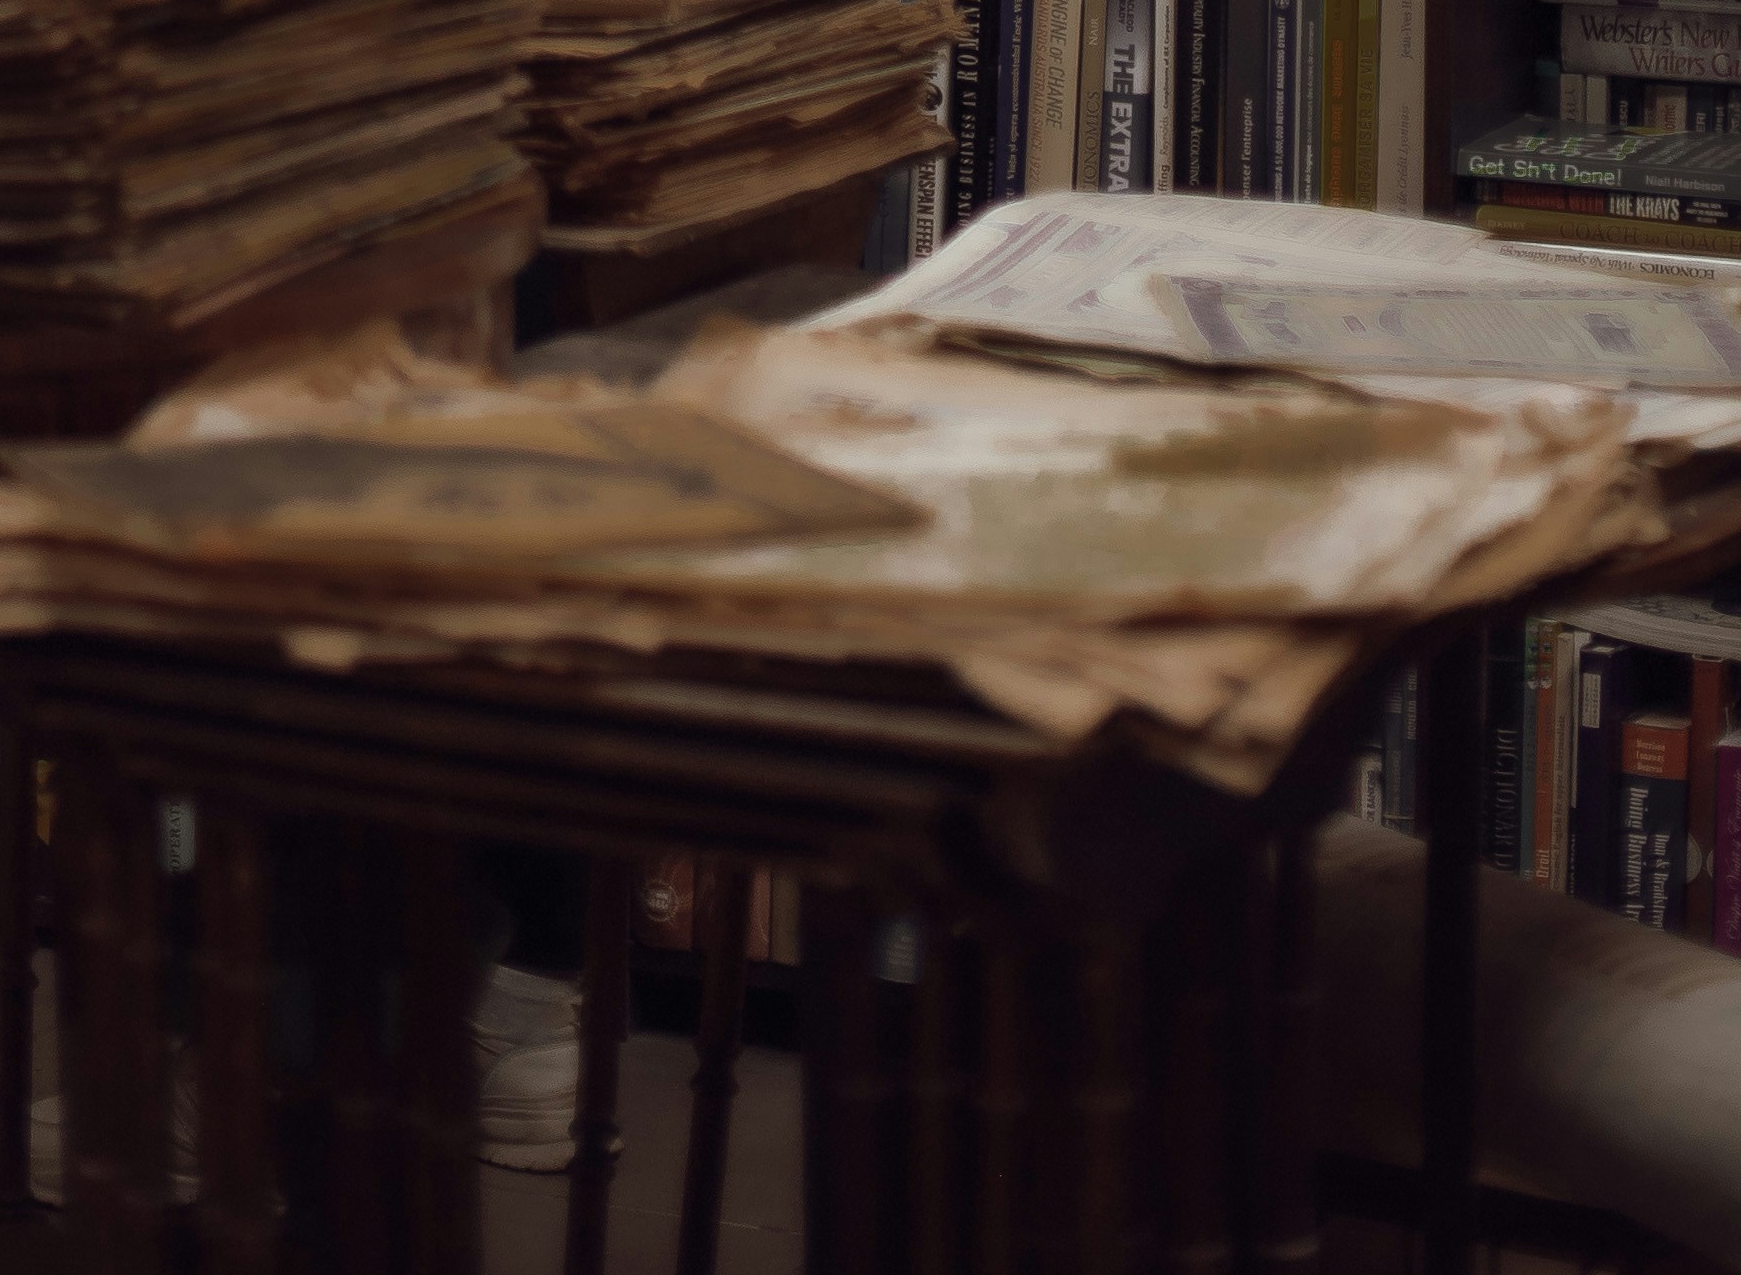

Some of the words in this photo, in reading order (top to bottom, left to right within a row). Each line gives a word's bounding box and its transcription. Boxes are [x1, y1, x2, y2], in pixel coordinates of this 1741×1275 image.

[1113, 43, 1136, 96] THE
[1108, 101, 1133, 192] EXTRA
[1564, 165, 1622, 185] Done!
[1609, 195, 1634, 216] THE
[1636, 197, 1680, 221] KRAYS
